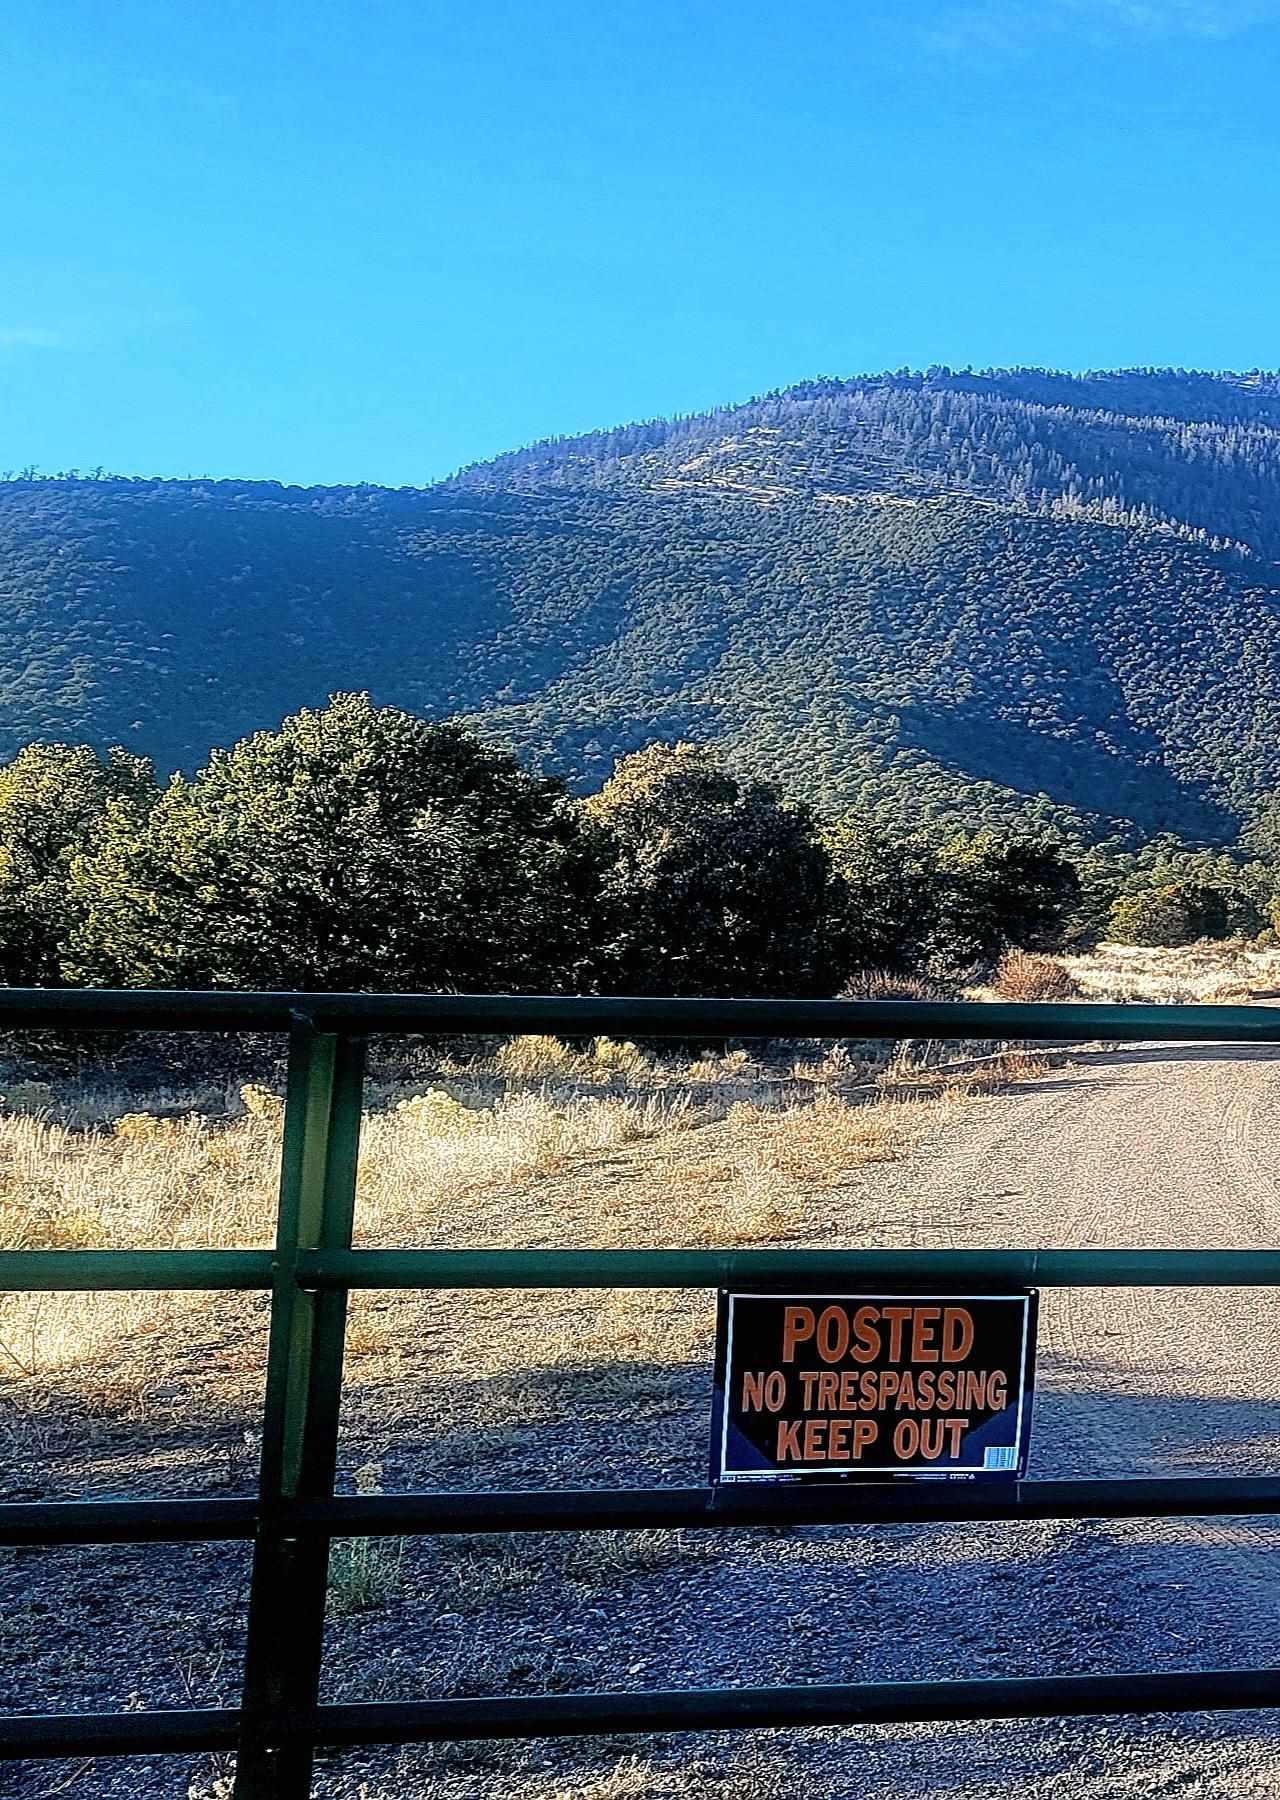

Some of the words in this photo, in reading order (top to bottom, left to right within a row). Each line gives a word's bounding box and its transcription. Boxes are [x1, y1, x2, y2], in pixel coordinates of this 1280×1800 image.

[782, 1305, 974, 1364] POSTED
[741, 1370, 786, 1413] NO
[799, 1369, 1008, 1412] TRESPASSING
[776, 1419, 879, 1461] KEEP
[892, 1418, 969, 1460] OUT
